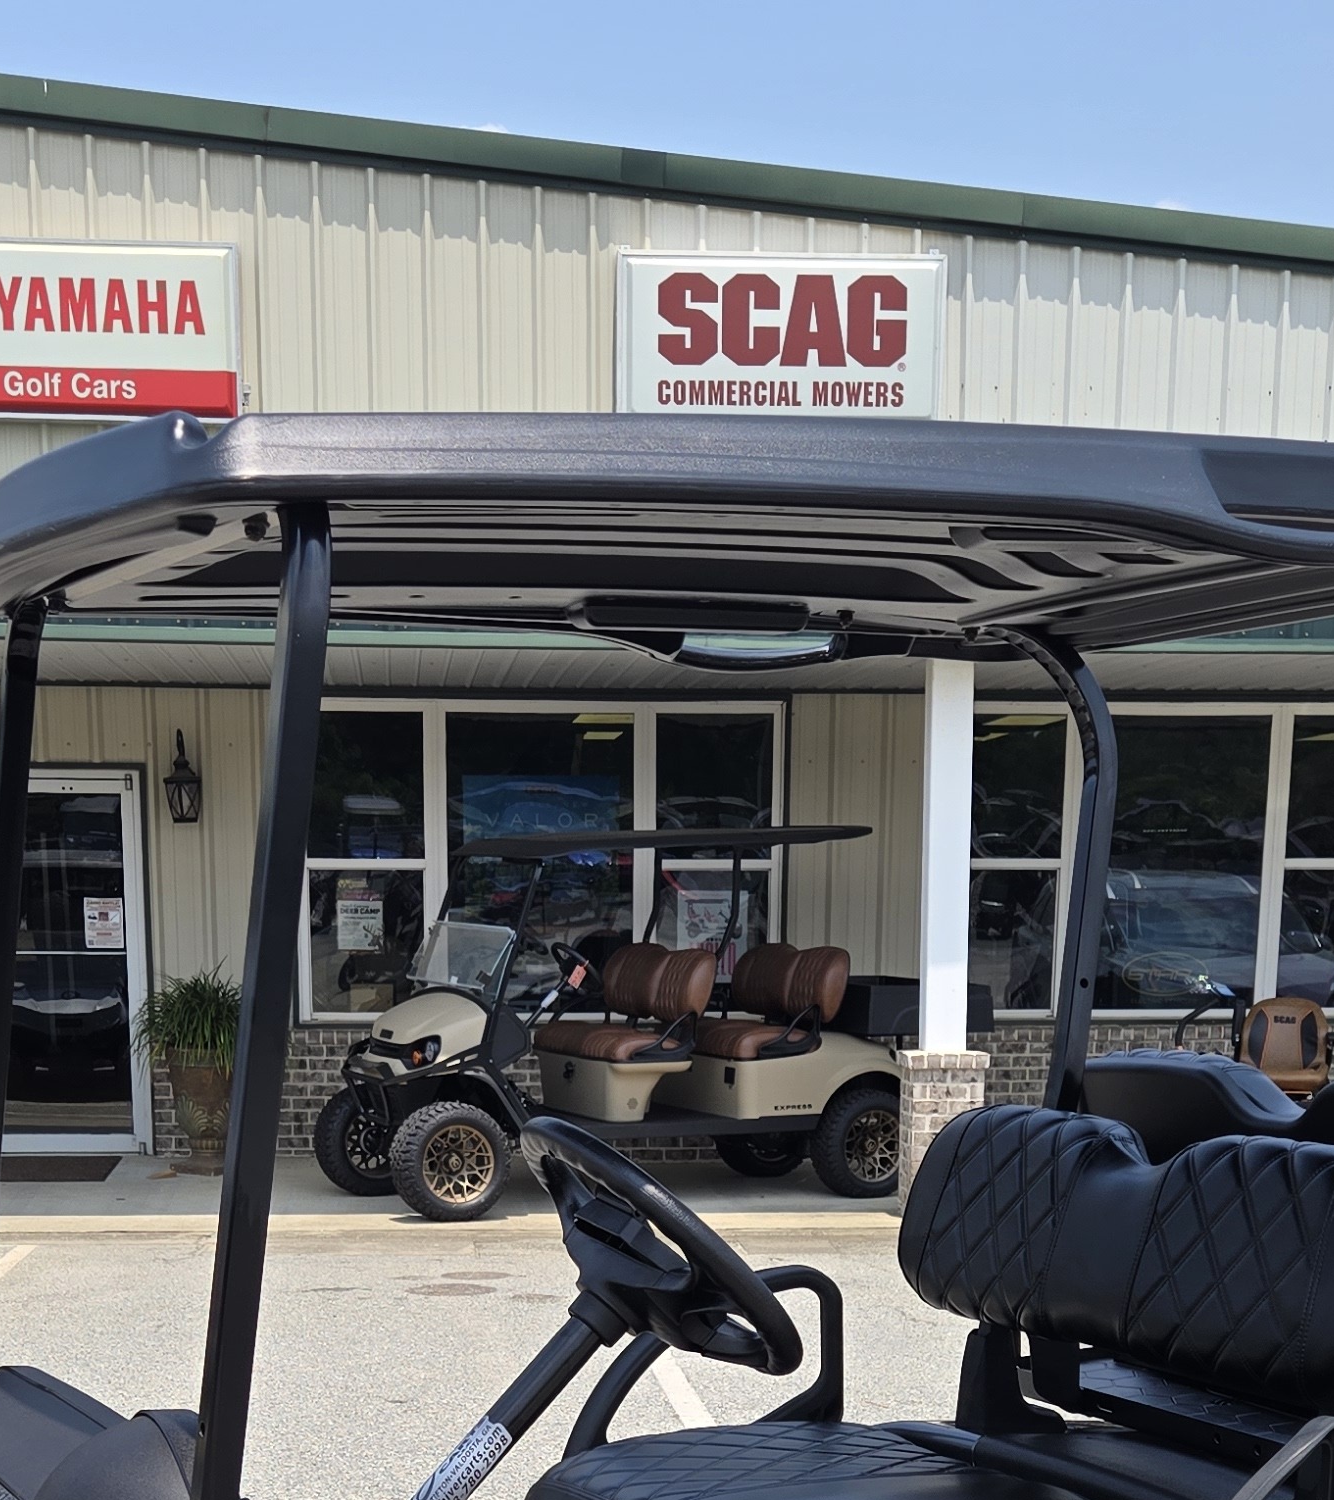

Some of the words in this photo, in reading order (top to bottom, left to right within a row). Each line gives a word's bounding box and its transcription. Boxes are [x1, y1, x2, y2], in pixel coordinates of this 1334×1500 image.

[657, 272, 908, 368] SCAG
[3, 371, 62, 397] Golf
[71, 372, 137, 400] Cars
[657, 379, 802, 407] COMMERCIAL
[812, 381, 905, 408] MOWERS
[484, 812, 600, 828] VALOR
[481, 1425, 493, 1437] GA
